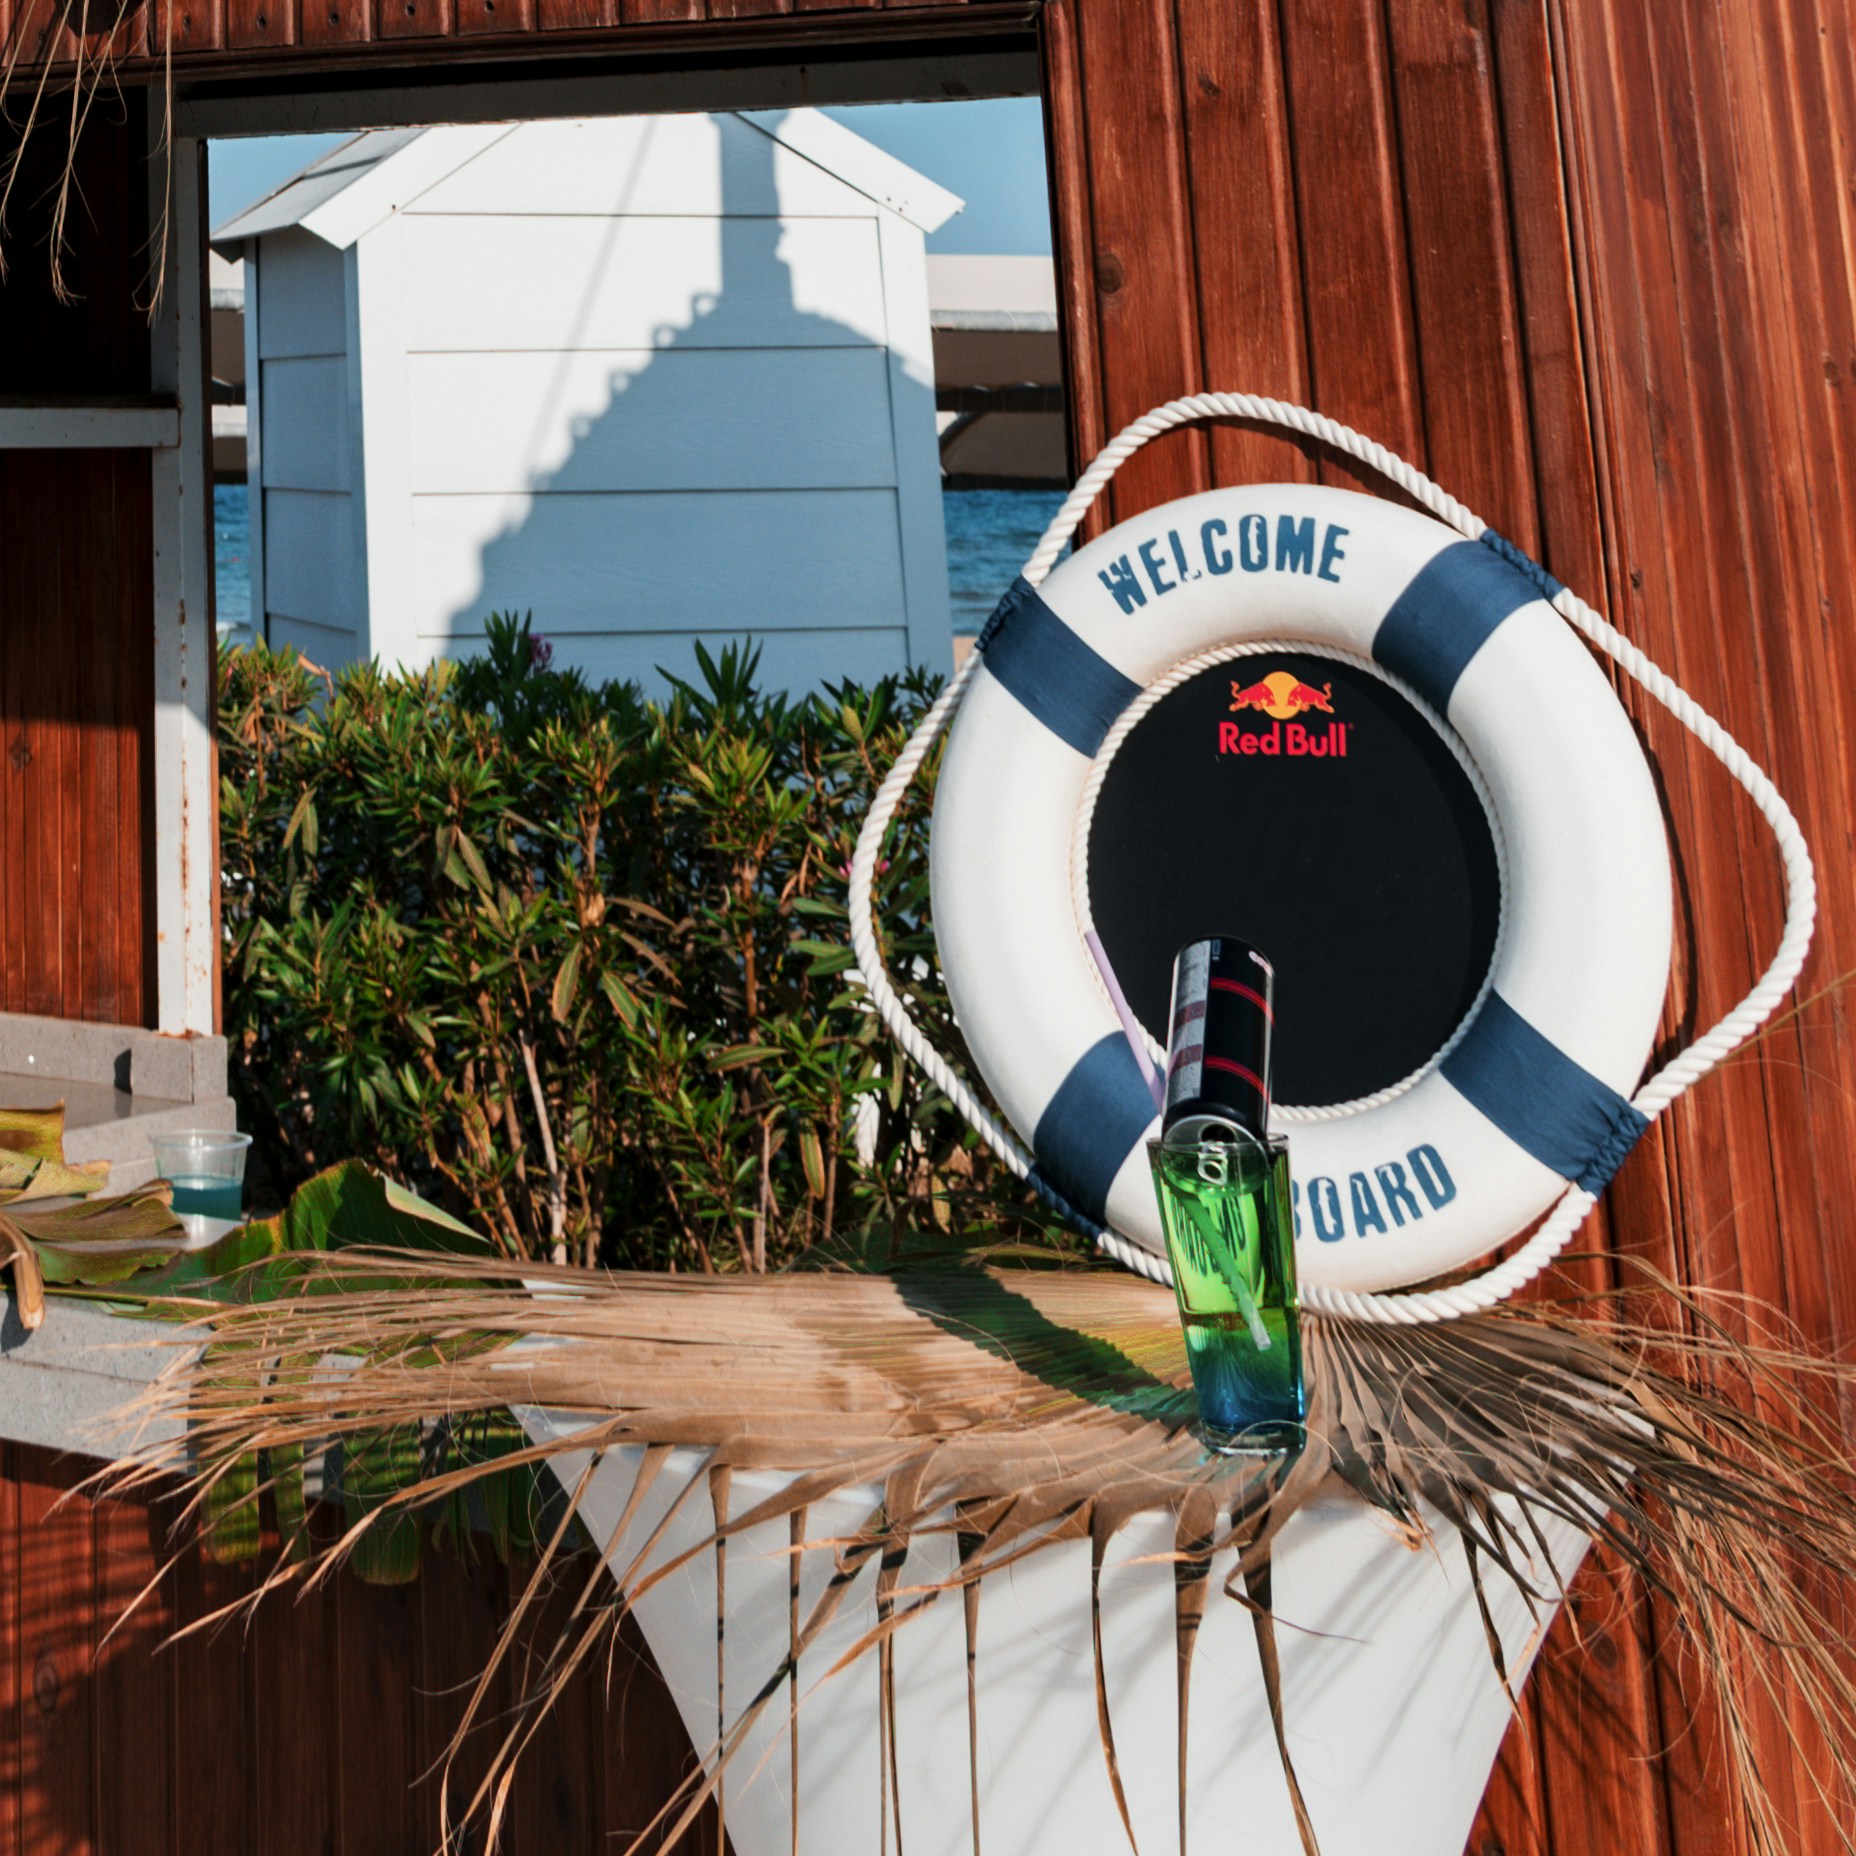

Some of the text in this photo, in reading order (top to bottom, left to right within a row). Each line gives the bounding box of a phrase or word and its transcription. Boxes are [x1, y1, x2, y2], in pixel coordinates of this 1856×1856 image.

[1097, 514, 1350, 615] WELCOME
[1218, 720, 1348, 758] Red Bull
[1292, 1143, 1458, 1243] OARD
